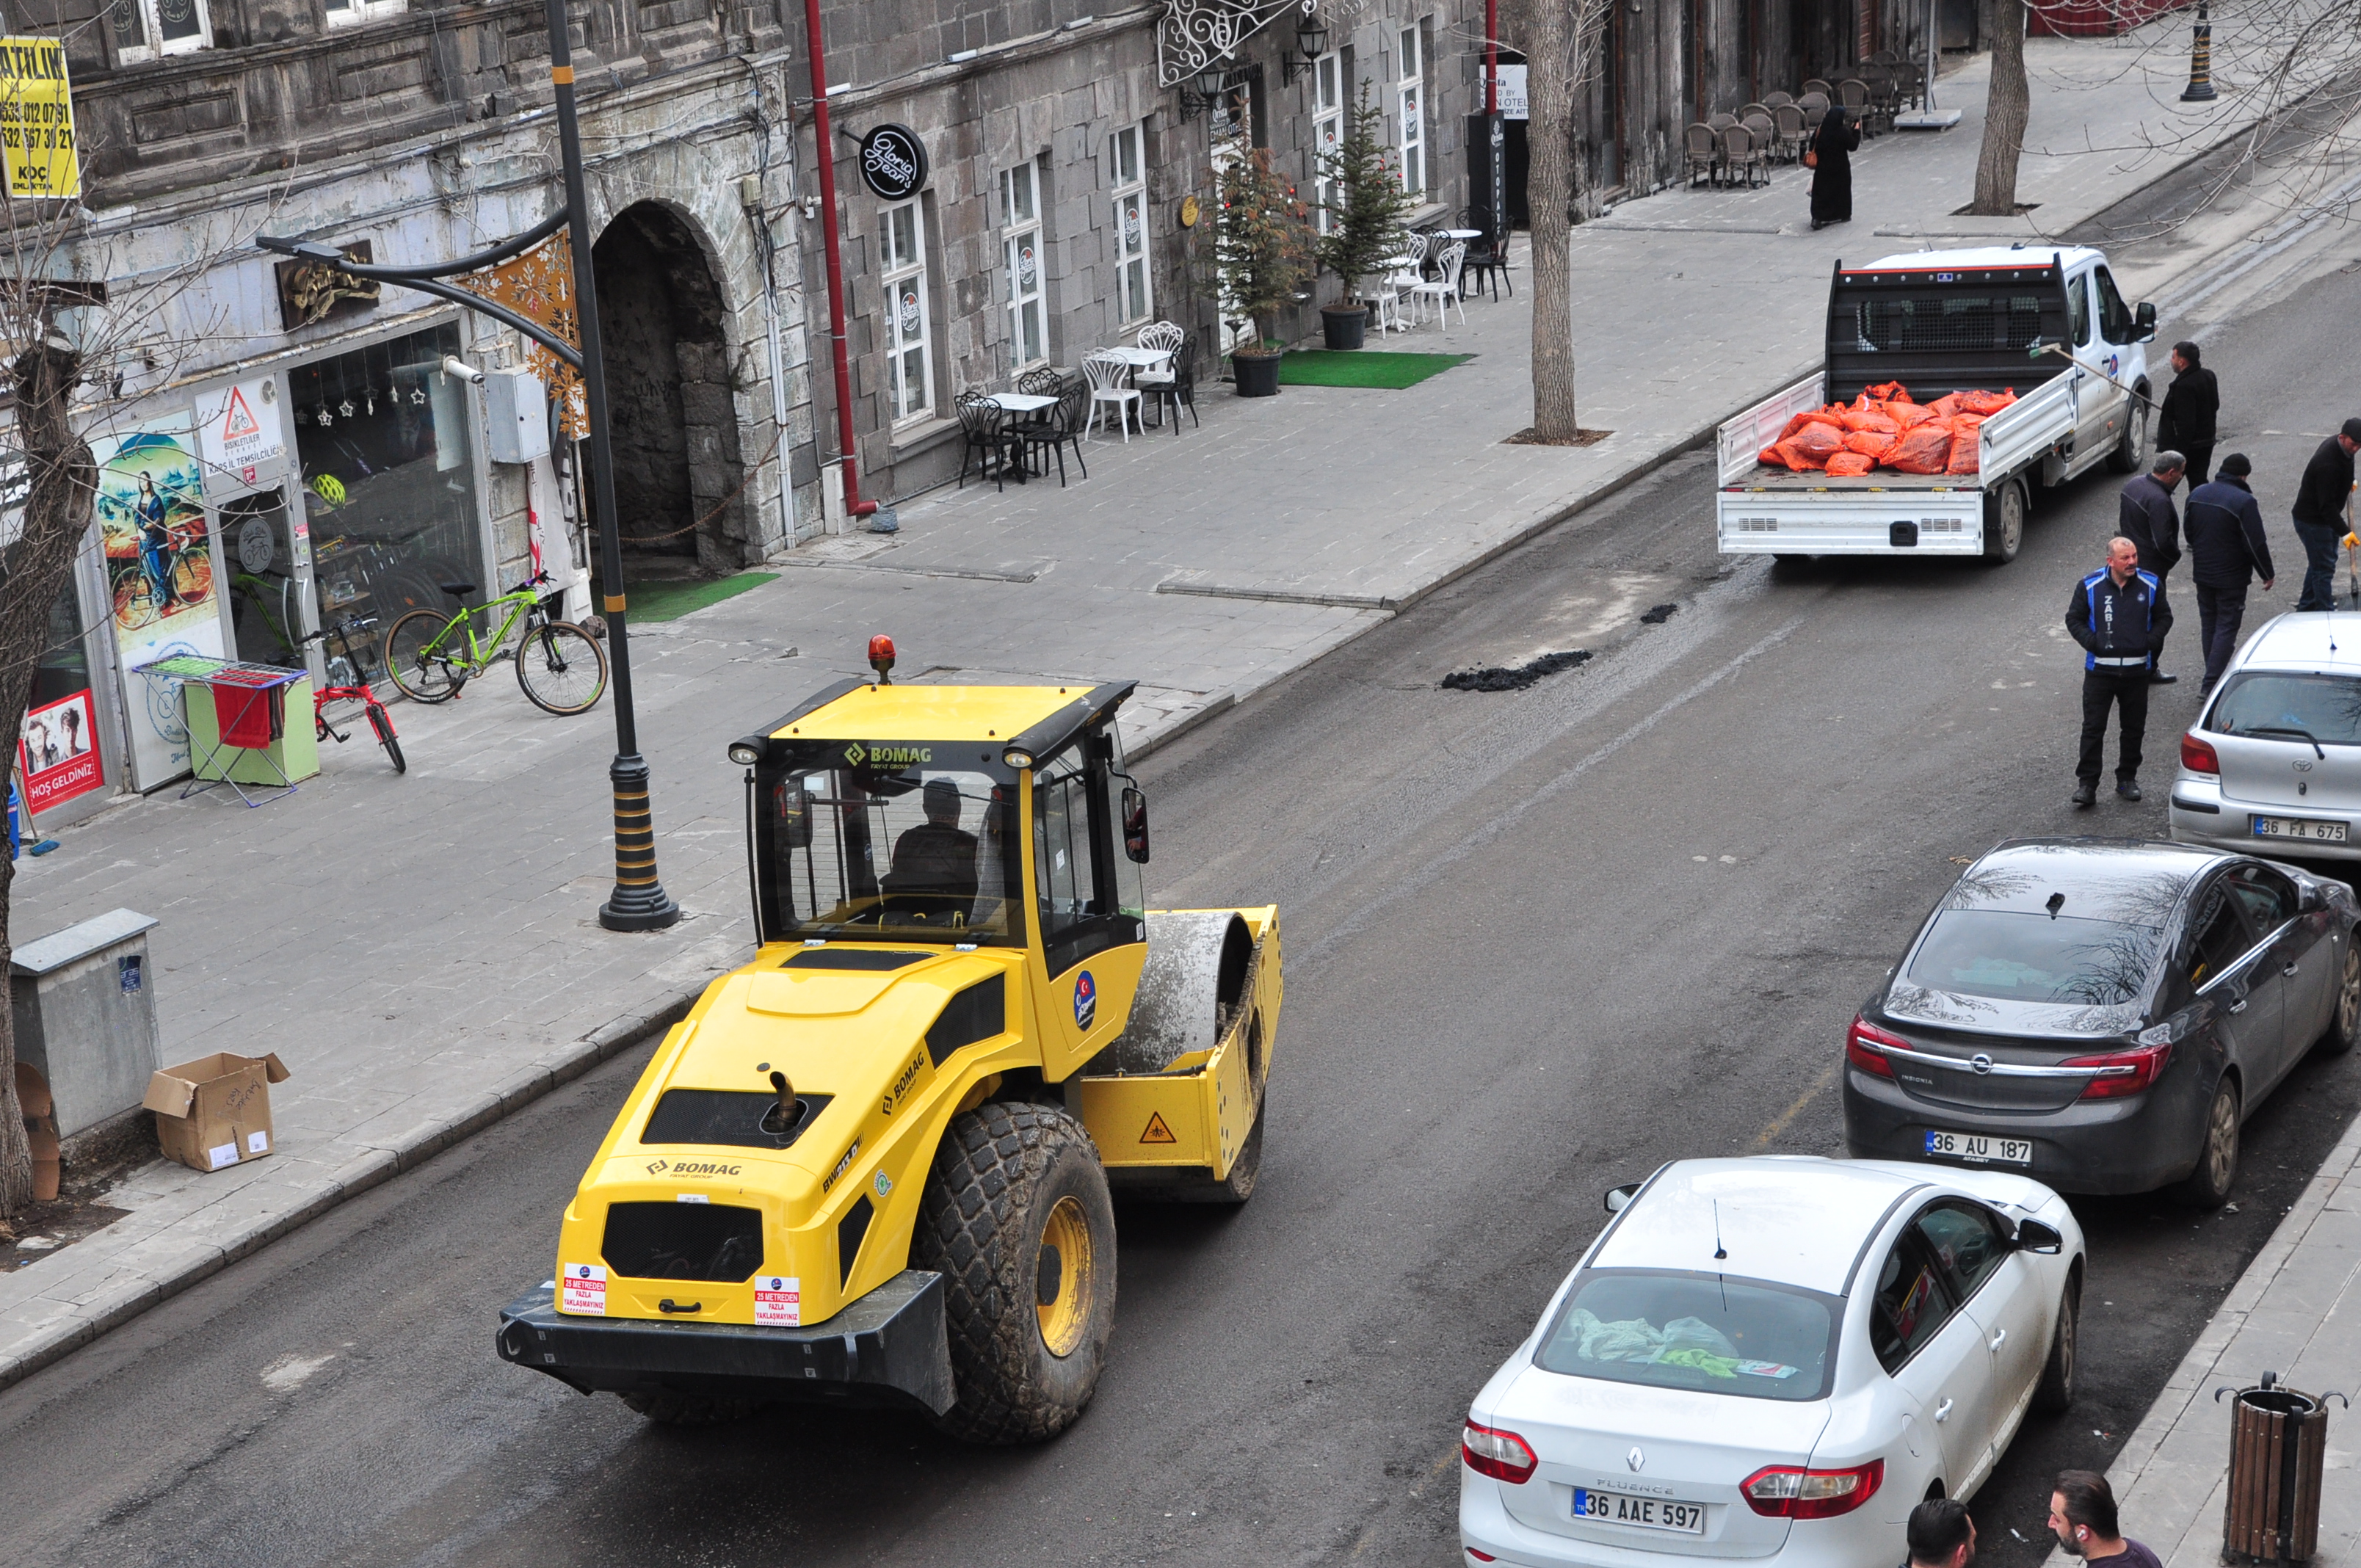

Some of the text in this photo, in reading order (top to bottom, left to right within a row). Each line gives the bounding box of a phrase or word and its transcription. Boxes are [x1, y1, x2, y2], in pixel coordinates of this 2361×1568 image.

[0, 46, 65, 80] ATILIK
[1, 127, 20, 148] 532
[865, 137, 913, 175] Gloria
[18, 166, 47, 182] KOÇ
[866, 156, 913, 189] Jean's
[228, 459, 236, 469] İL
[2104, 595, 2114, 649] ZABITA
[871, 747, 932, 762] BOMAG
[31, 763, 93, 799] HOŞ GELDİNİZ
[2262, 820, 2279, 834] 36
[2289, 823, 2306, 836] FA
[2316, 825, 2343, 839] 675
[893, 1051, 924, 1100] BOMAG
[1901, 1074, 1934, 1085] INSIGNIA
[1933, 1133, 1955, 1151] 36
[1965, 1136, 1989, 1155] AU
[1999, 1140, 2029, 1160] 187
[672, 1162, 742, 1175] BOMAG
[565, 1280, 605, 1291] 25 METREDEN
[756, 1292, 798, 1302] 25 METREDEN
[1597, 1478, 1674, 1495] FLUENCE
[1586, 1494, 1609, 1517] 36
[1617, 1498, 1655, 1523] AAE
[1663, 1504, 1700, 1529] 597
